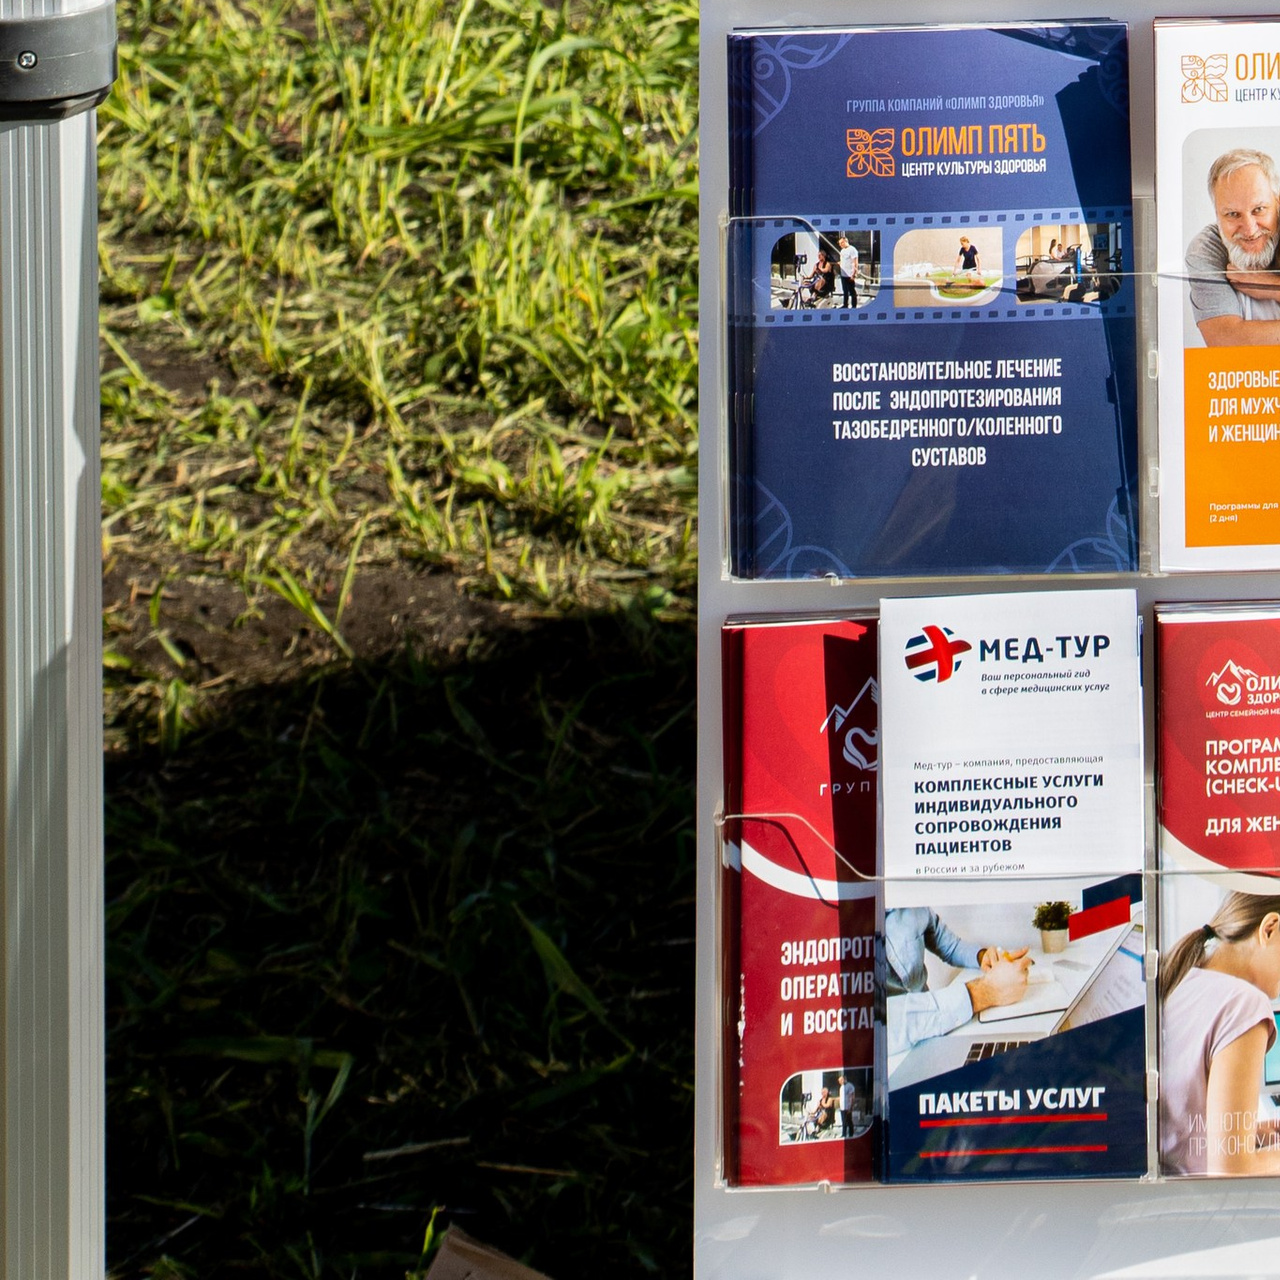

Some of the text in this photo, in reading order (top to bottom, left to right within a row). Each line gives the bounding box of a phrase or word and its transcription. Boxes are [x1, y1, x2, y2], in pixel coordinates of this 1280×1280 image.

[847, 95, 1044, 113] ГРУППА КОМПАНИЙ «ОЛИМП ЗДОРОВЬЯ»
[902, 124, 1046, 156] ОЛИМП ПЯТЬ
[902, 158, 1046, 179] ЦЕНТР КУЛЬТУРЫ ЗДОРОВЬЯ
[833, 358, 1062, 383] ВОССТАНОВИТЕЛЬНОЕ ЛЕЧЕНИЕ
[1208, 370, 1280, 392] ЗДОРОВЫЕ
[833, 387, 1061, 412] ПОСЛЕ ЭНДОПРОТЕЗИРОВАНИЯ
[1208, 399, 1238, 418] ДЛЯ
[833, 415, 1063, 441] ТАЗОБЕДРЕННОГО/КОЛЕННОГО
[1208, 426, 1217, 443] И
[912, 446, 987, 467] СУСТАВОВ
[980, 635, 1111, 664] МЕД-ТУР
[1206, 818, 1241, 836] ДЛЯ
[919, 1086, 1106, 1115] ПАКЕТЫ УСЛУГ
